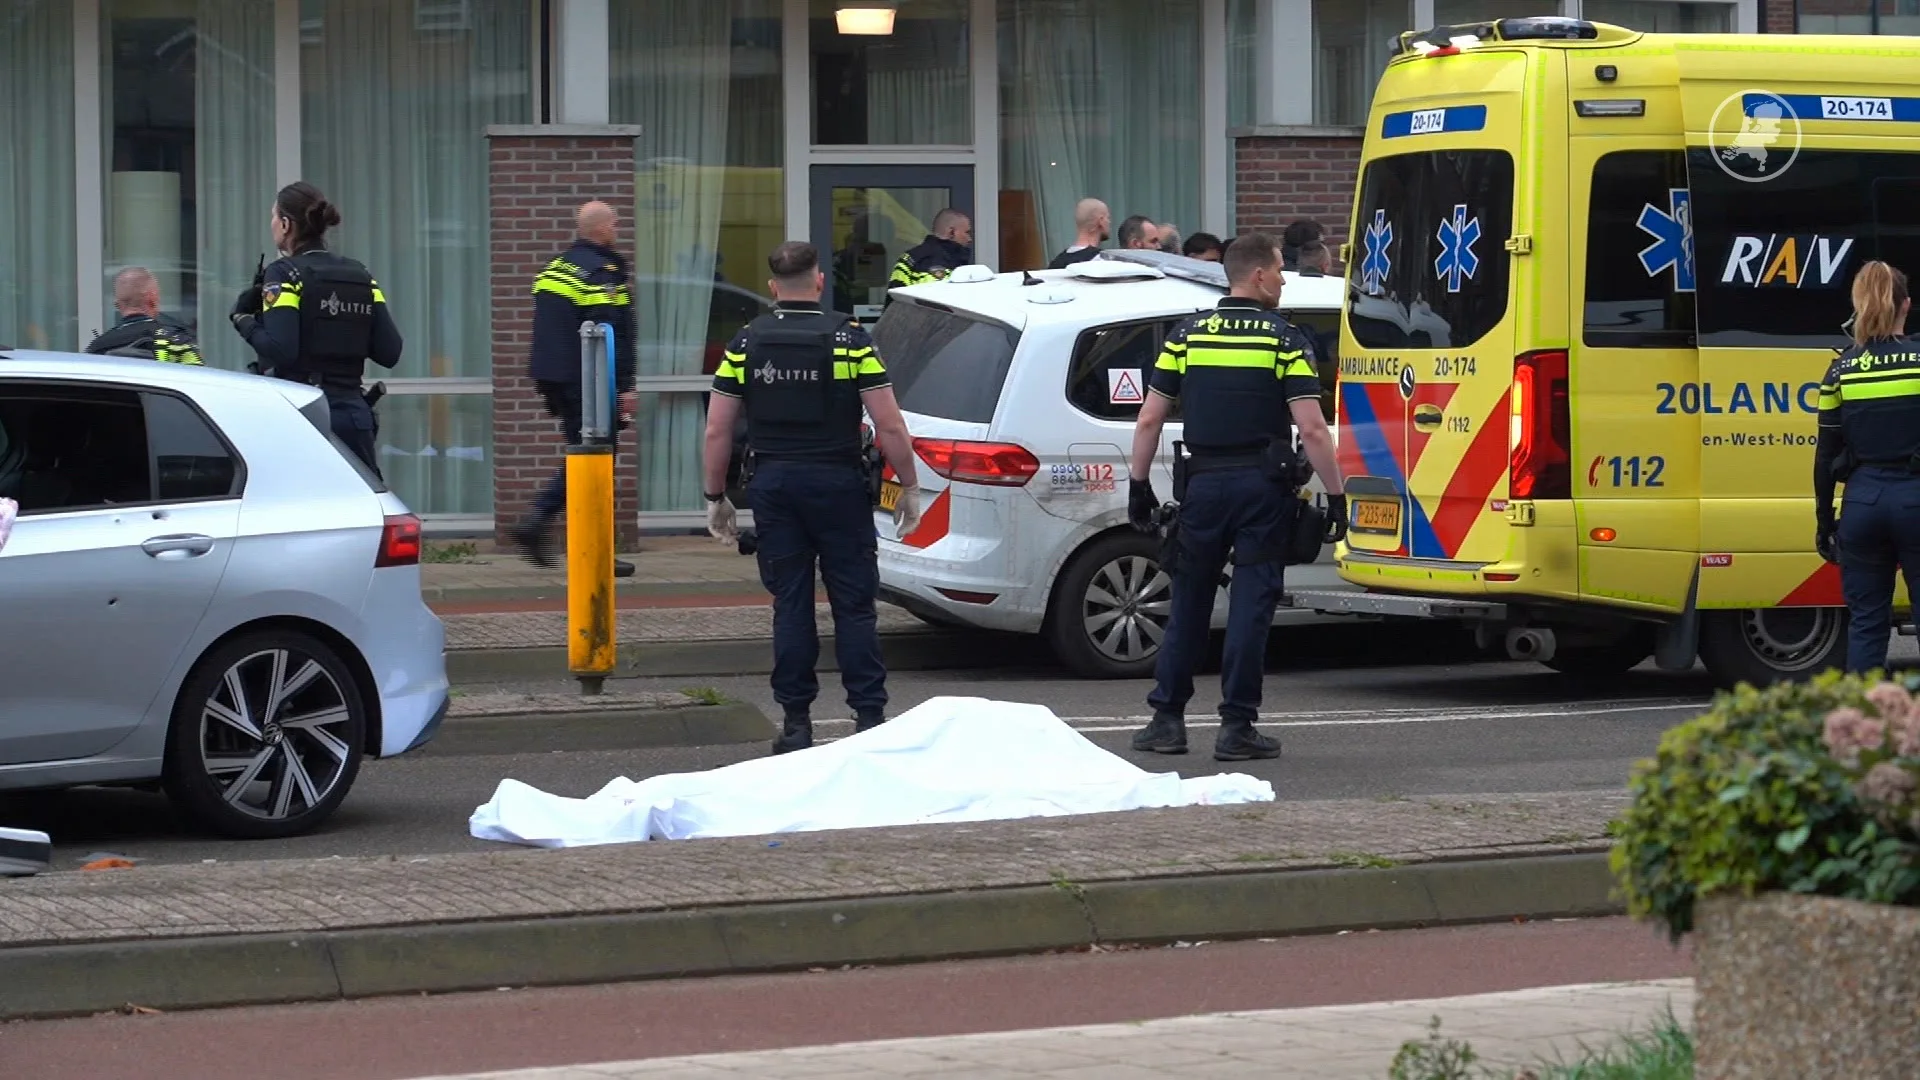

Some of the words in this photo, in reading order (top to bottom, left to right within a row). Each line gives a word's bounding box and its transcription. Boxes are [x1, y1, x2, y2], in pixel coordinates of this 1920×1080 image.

[1827, 101, 1887, 115] 20-174
[1413, 113, 1441, 130] 20-174
[320, 291, 372, 315] POLITIE
[1197, 313, 1271, 333] POLITIE
[1340, 357, 1399, 376] AMBULANCE
[1434, 357, 1476, 376] 20-174
[1851, 350, 1917, 371] POLITIE
[754, 360, 819, 384] POLITIE
[1052, 464, 1081, 474] 0900
[1084, 464, 1113, 480] 112
[1705, 556, 1729, 565] WAS
